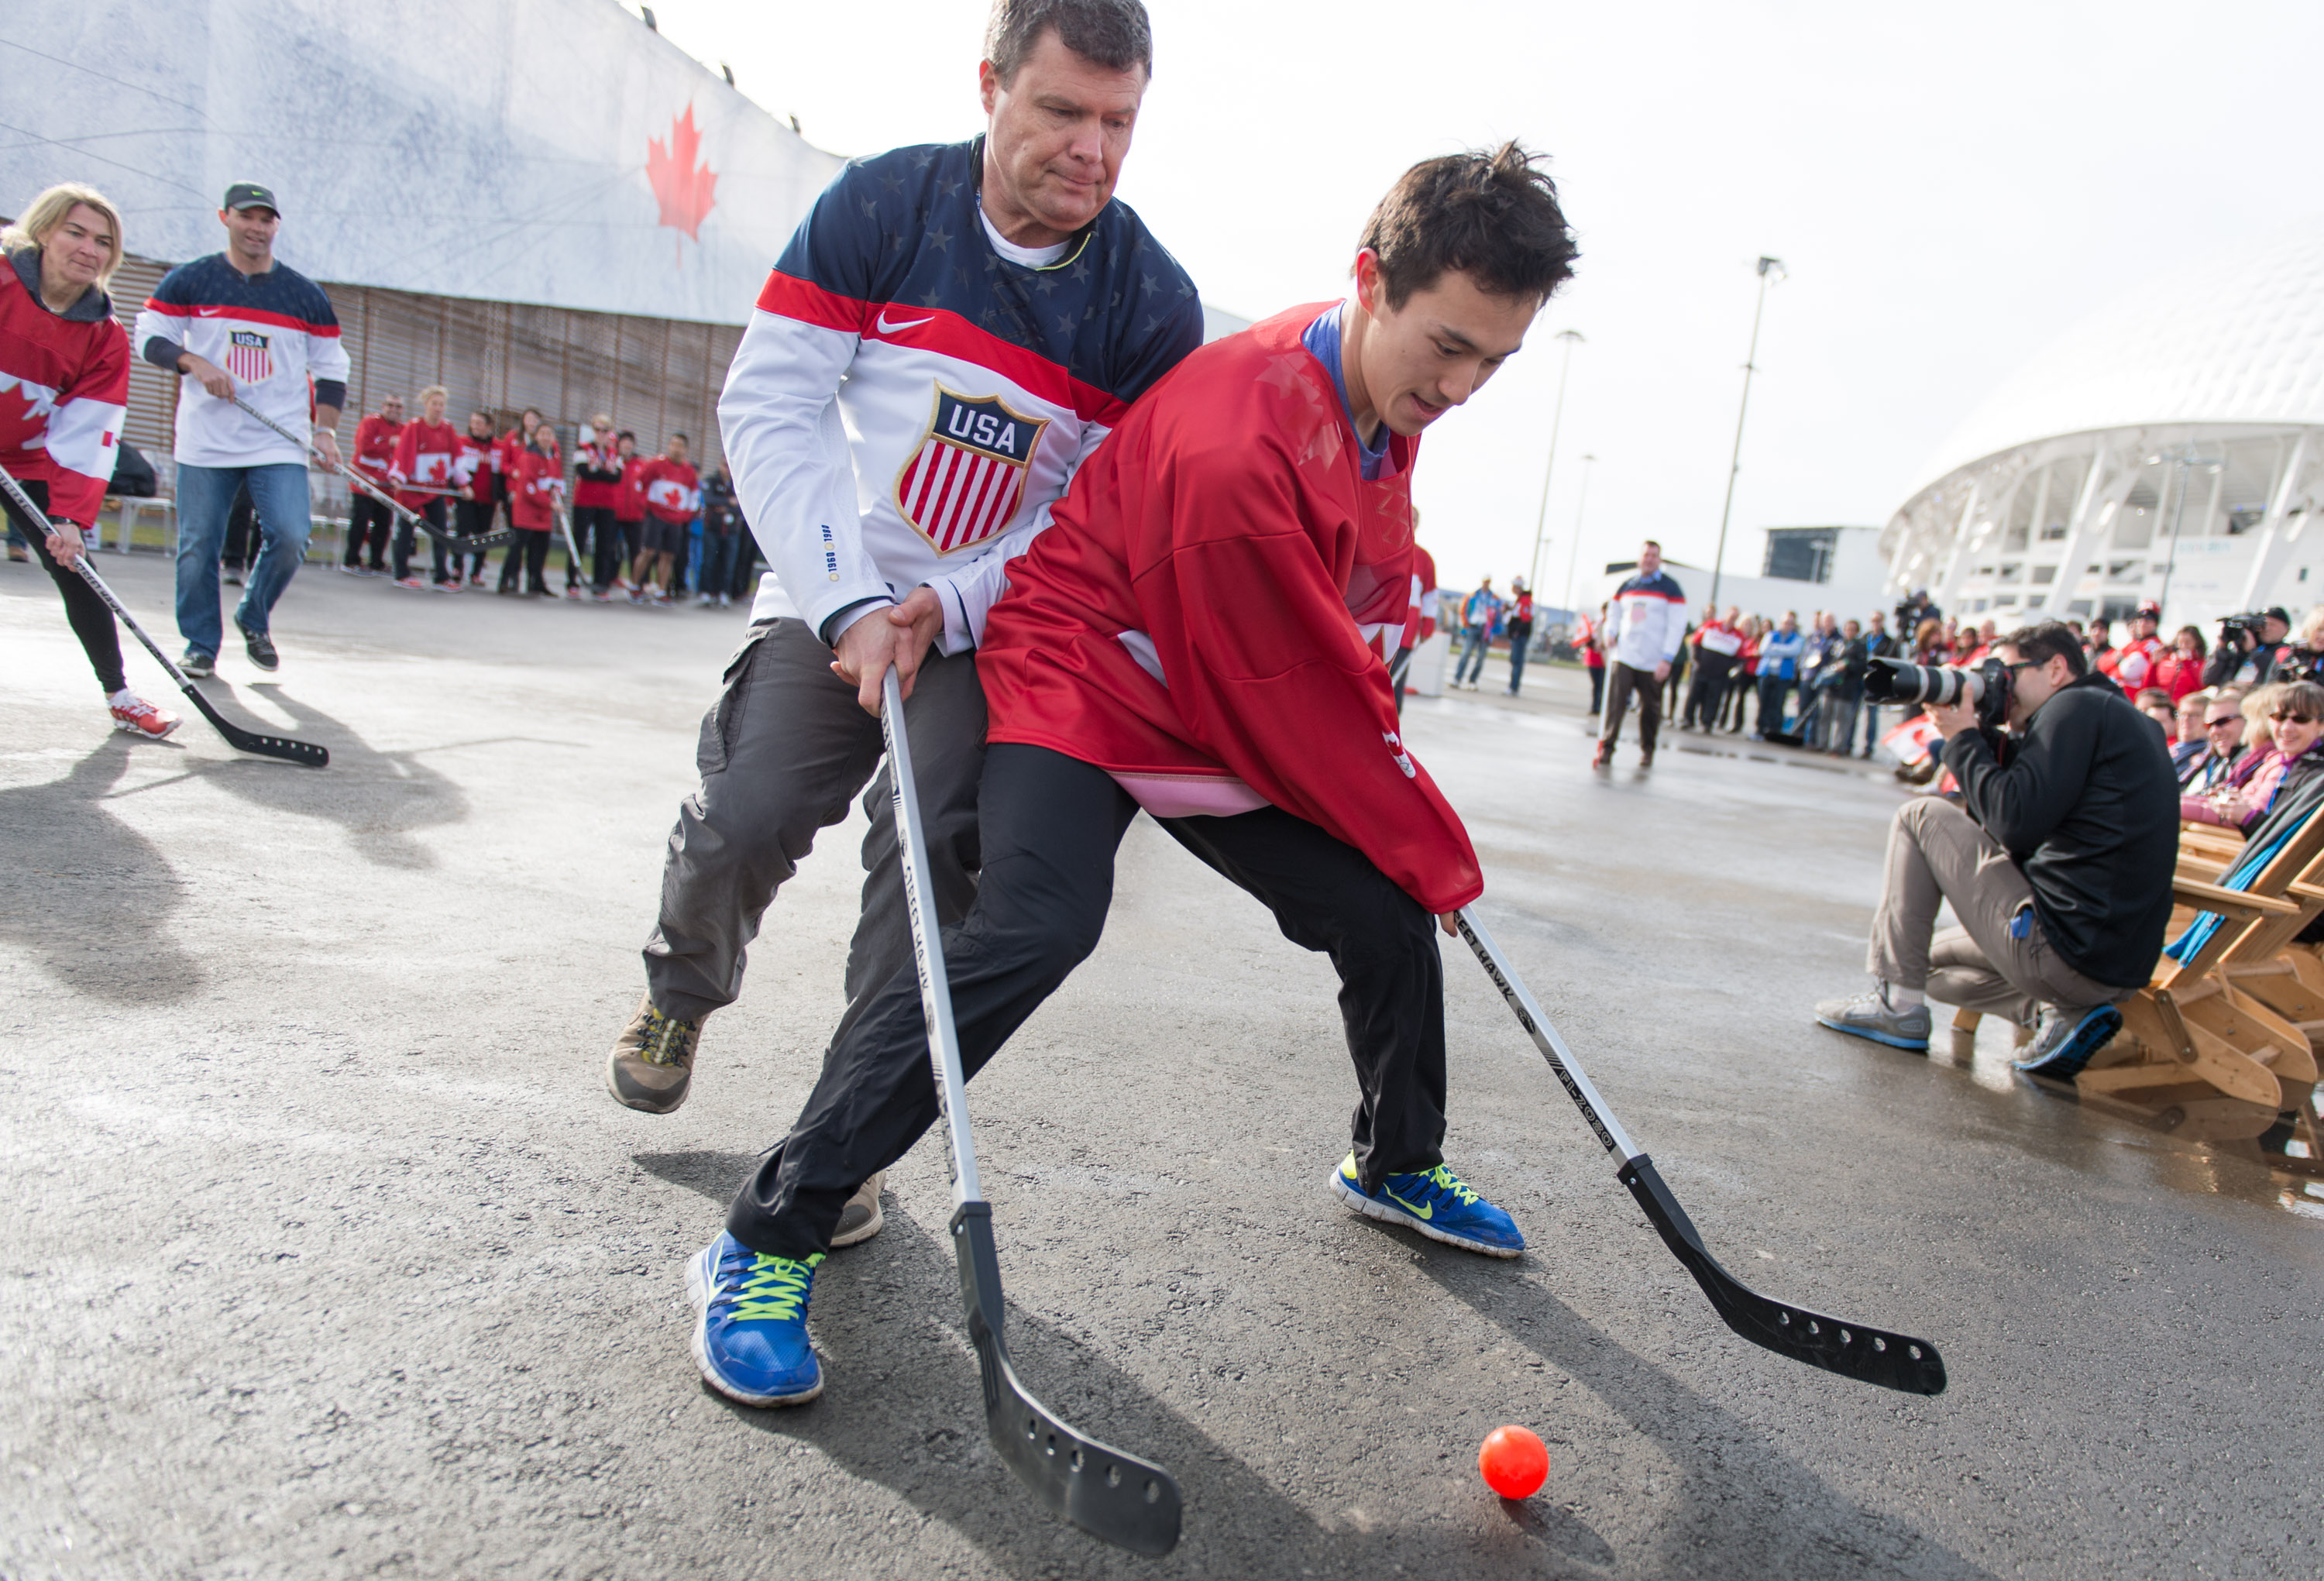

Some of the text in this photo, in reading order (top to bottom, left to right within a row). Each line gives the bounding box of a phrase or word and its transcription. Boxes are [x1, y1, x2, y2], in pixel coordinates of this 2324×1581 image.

[235, 333, 263, 347] USA
[948, 404, 1015, 454] USA
[826, 552, 837, 572] 1960
[1453, 910, 1514, 1002] REET HAWK
